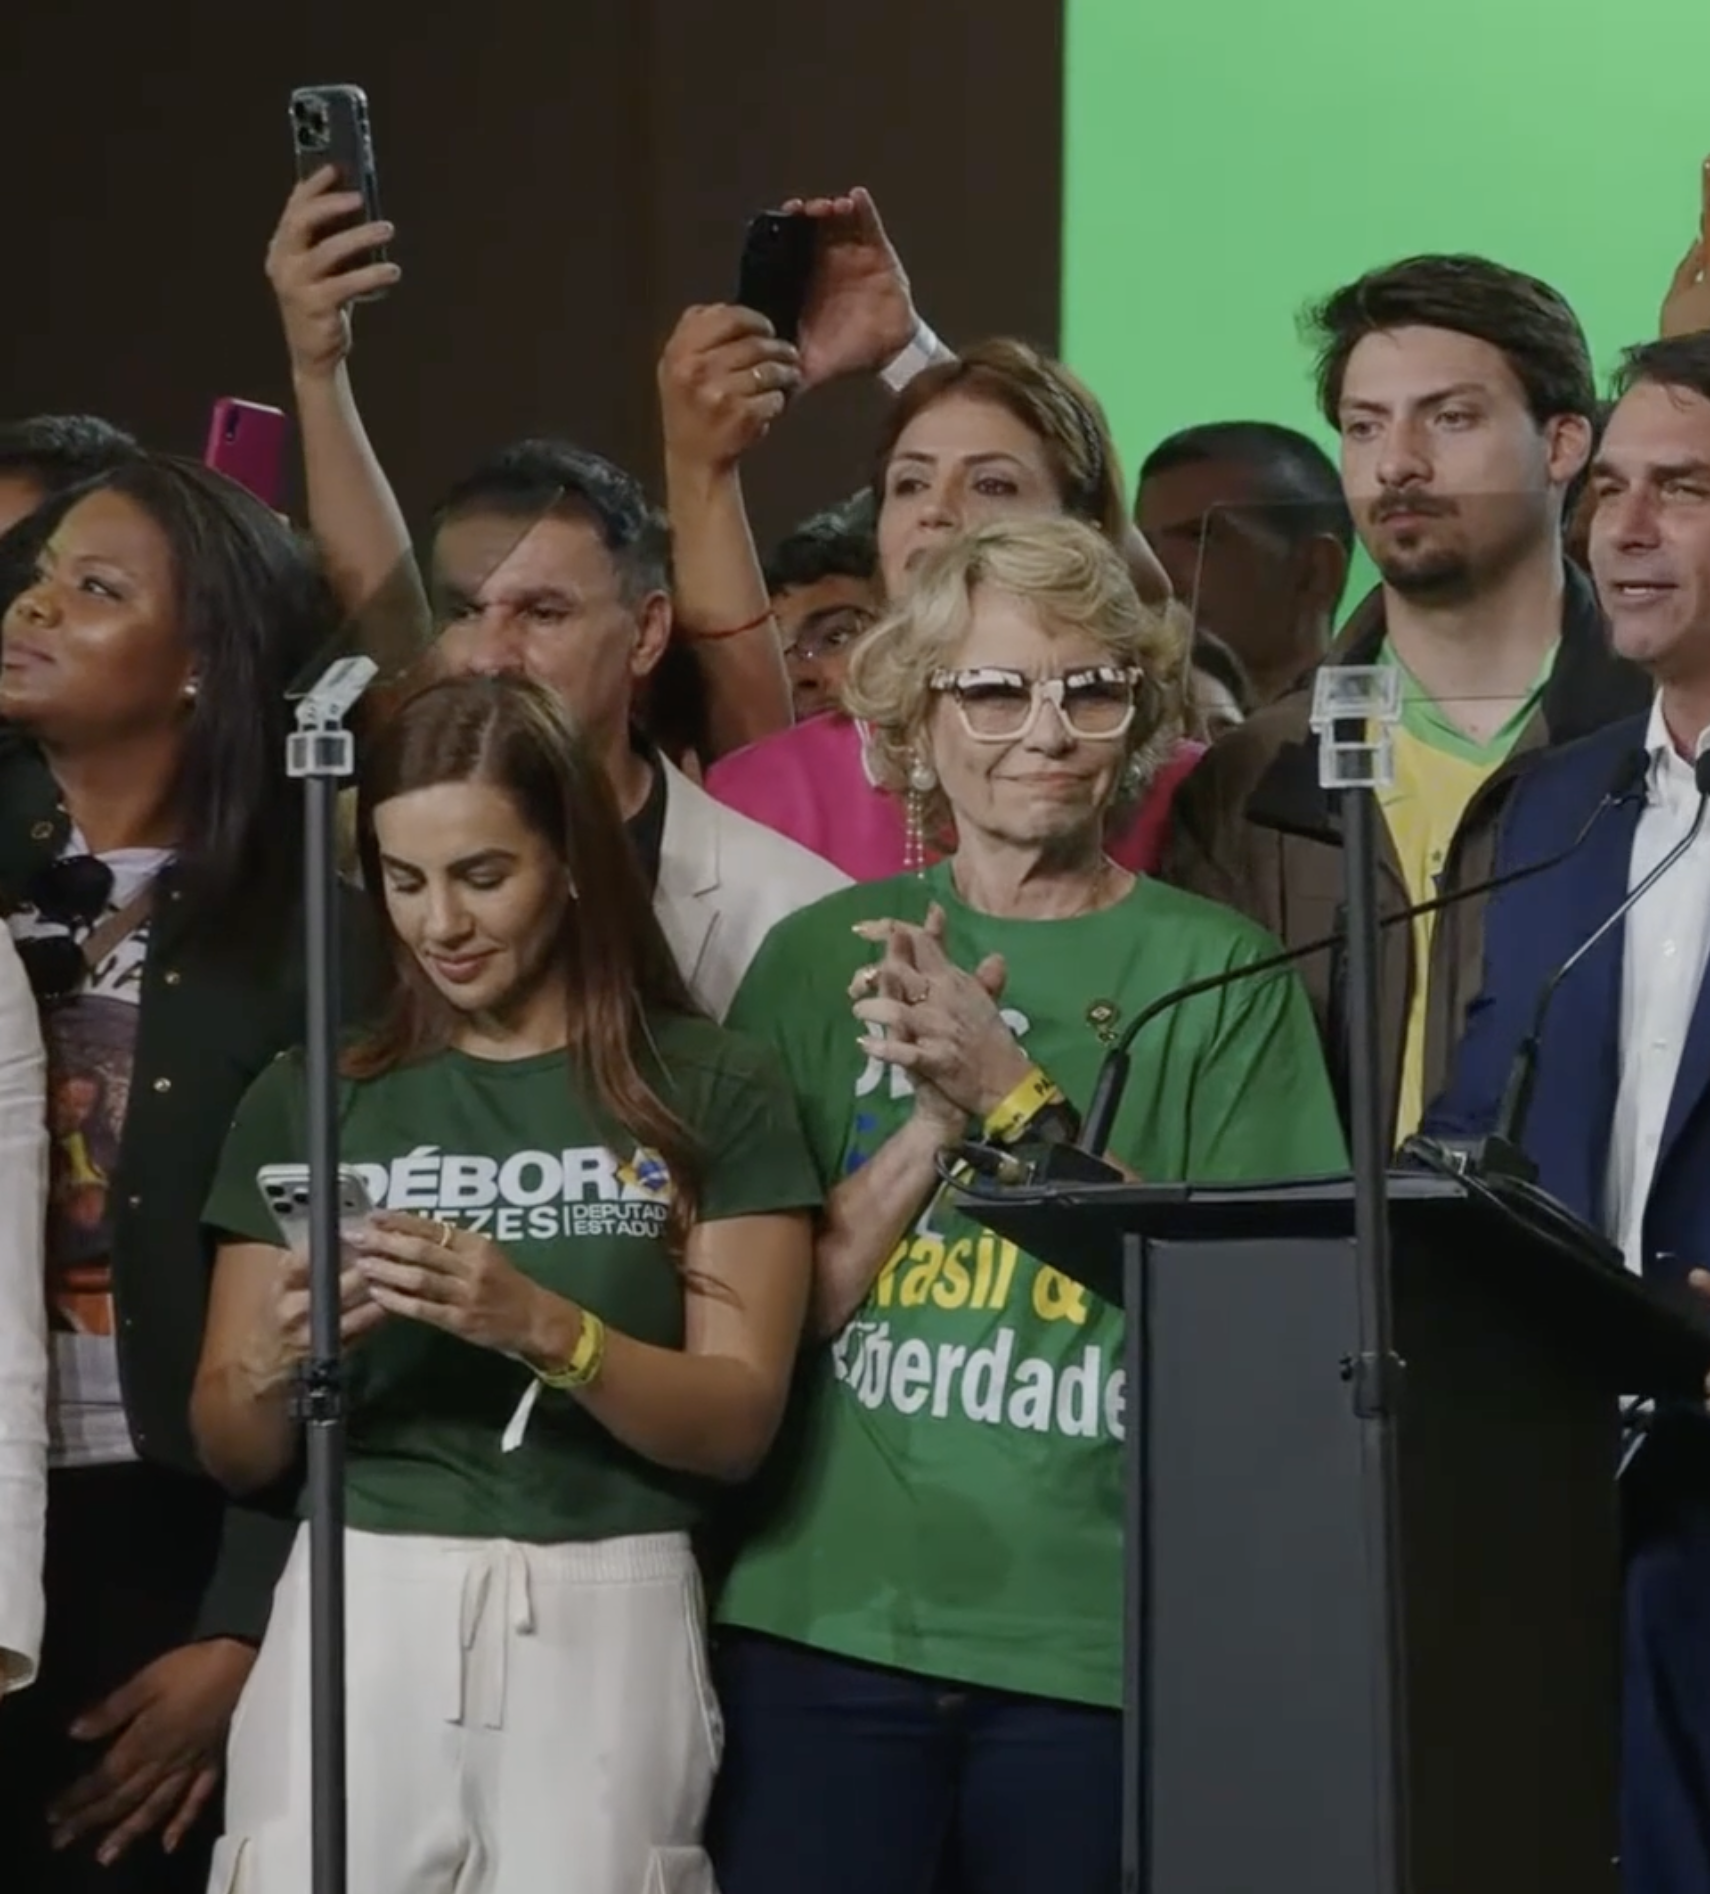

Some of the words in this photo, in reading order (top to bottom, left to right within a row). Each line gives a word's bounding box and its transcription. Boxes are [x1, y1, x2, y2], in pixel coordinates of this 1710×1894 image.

[572, 1203, 667, 1222] DEPUTAD
[573, 1219, 663, 1239] ESTADU
[876, 1228, 1018, 1309] rasil
